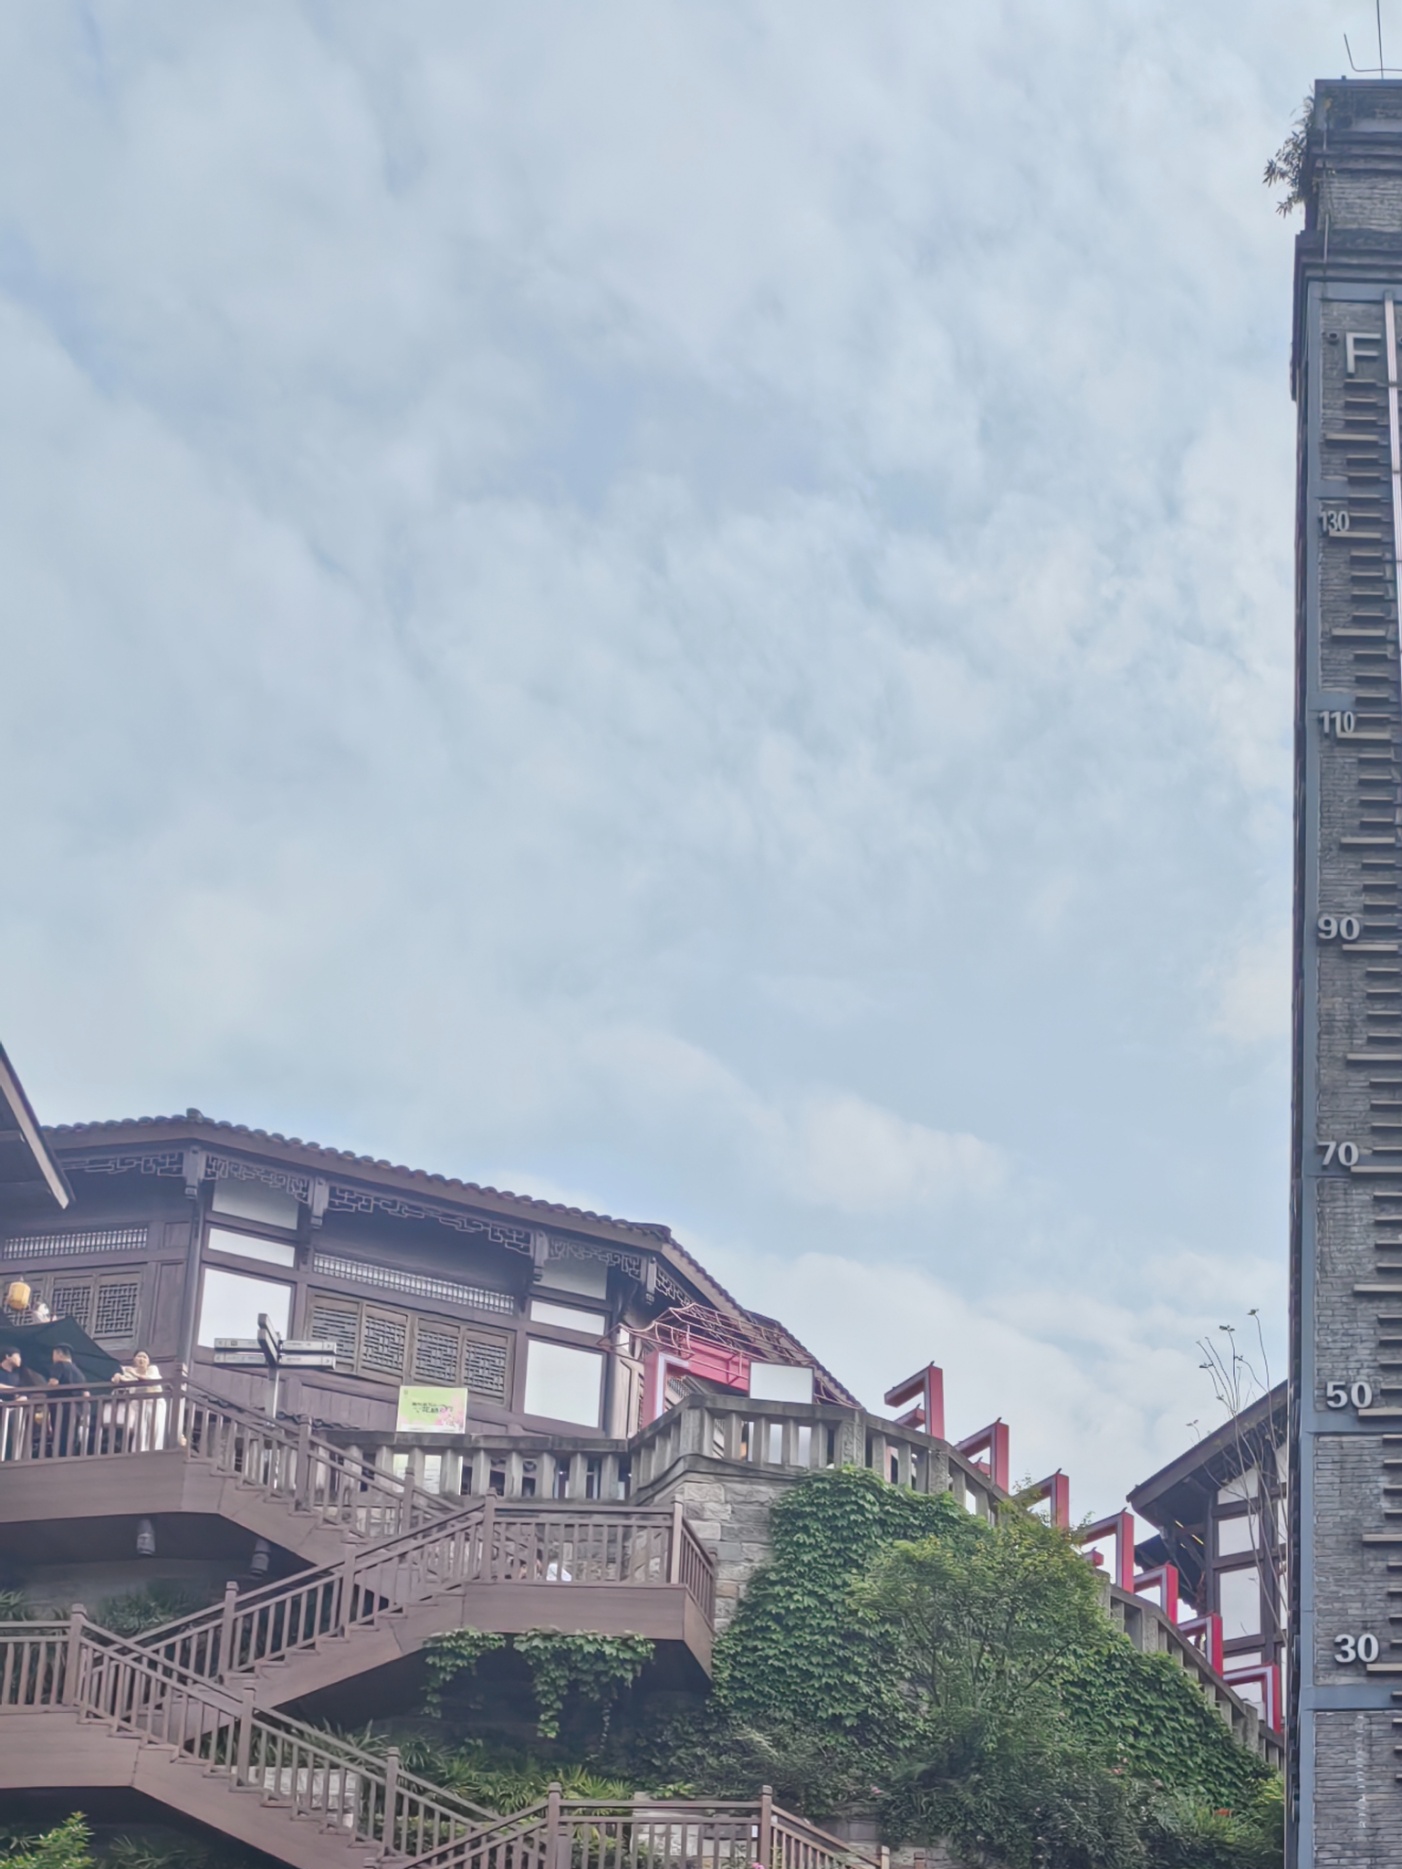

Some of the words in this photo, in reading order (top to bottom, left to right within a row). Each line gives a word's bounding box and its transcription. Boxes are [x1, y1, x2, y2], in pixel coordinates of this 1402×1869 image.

[1319, 511, 1350, 533] 130
[1319, 711, 1355, 734] 110
[1317, 916, 1361, 941] 90
[1319, 1140, 1360, 1167] 70
[1325, 1381, 1374, 1409] 50
[1333, 1633, 1380, 1664] 30
